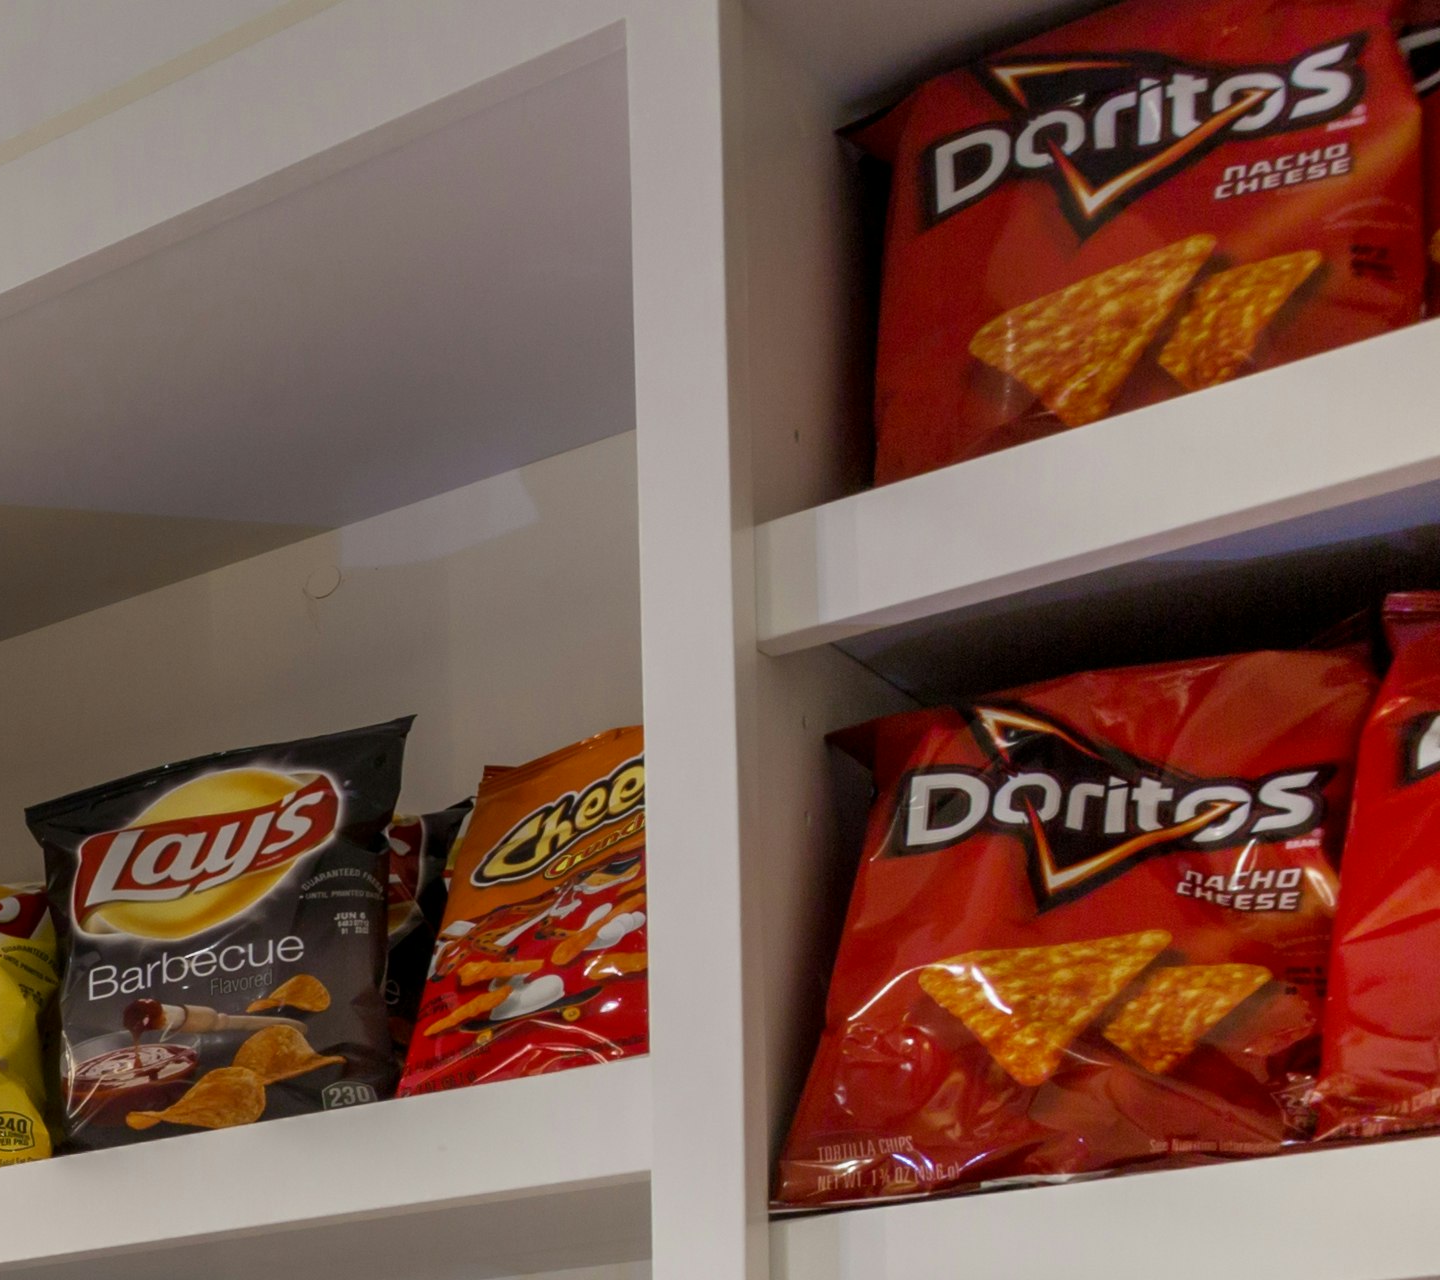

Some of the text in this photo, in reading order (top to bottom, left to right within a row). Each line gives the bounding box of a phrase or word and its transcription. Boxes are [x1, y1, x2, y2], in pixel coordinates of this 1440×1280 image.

[935, 41, 1355, 215] Doritos
[1214, 157, 1351, 201] CHEESE
[1224, 142, 1349, 182] NACHO
[906, 770, 1320, 848] Doritos
[84, 791, 324, 908] Lay's
[302, 868, 361, 893] GUARANTEED
[1176, 880, 1302, 911] CHEESE
[1185, 867, 1302, 892] NACHO
[89, 935, 305, 1001] Barbecue
[211, 969, 273, 997] Flavored
[329, 1084, 371, 1108] 230
[877, 1135, 914, 1156] CHIPS
